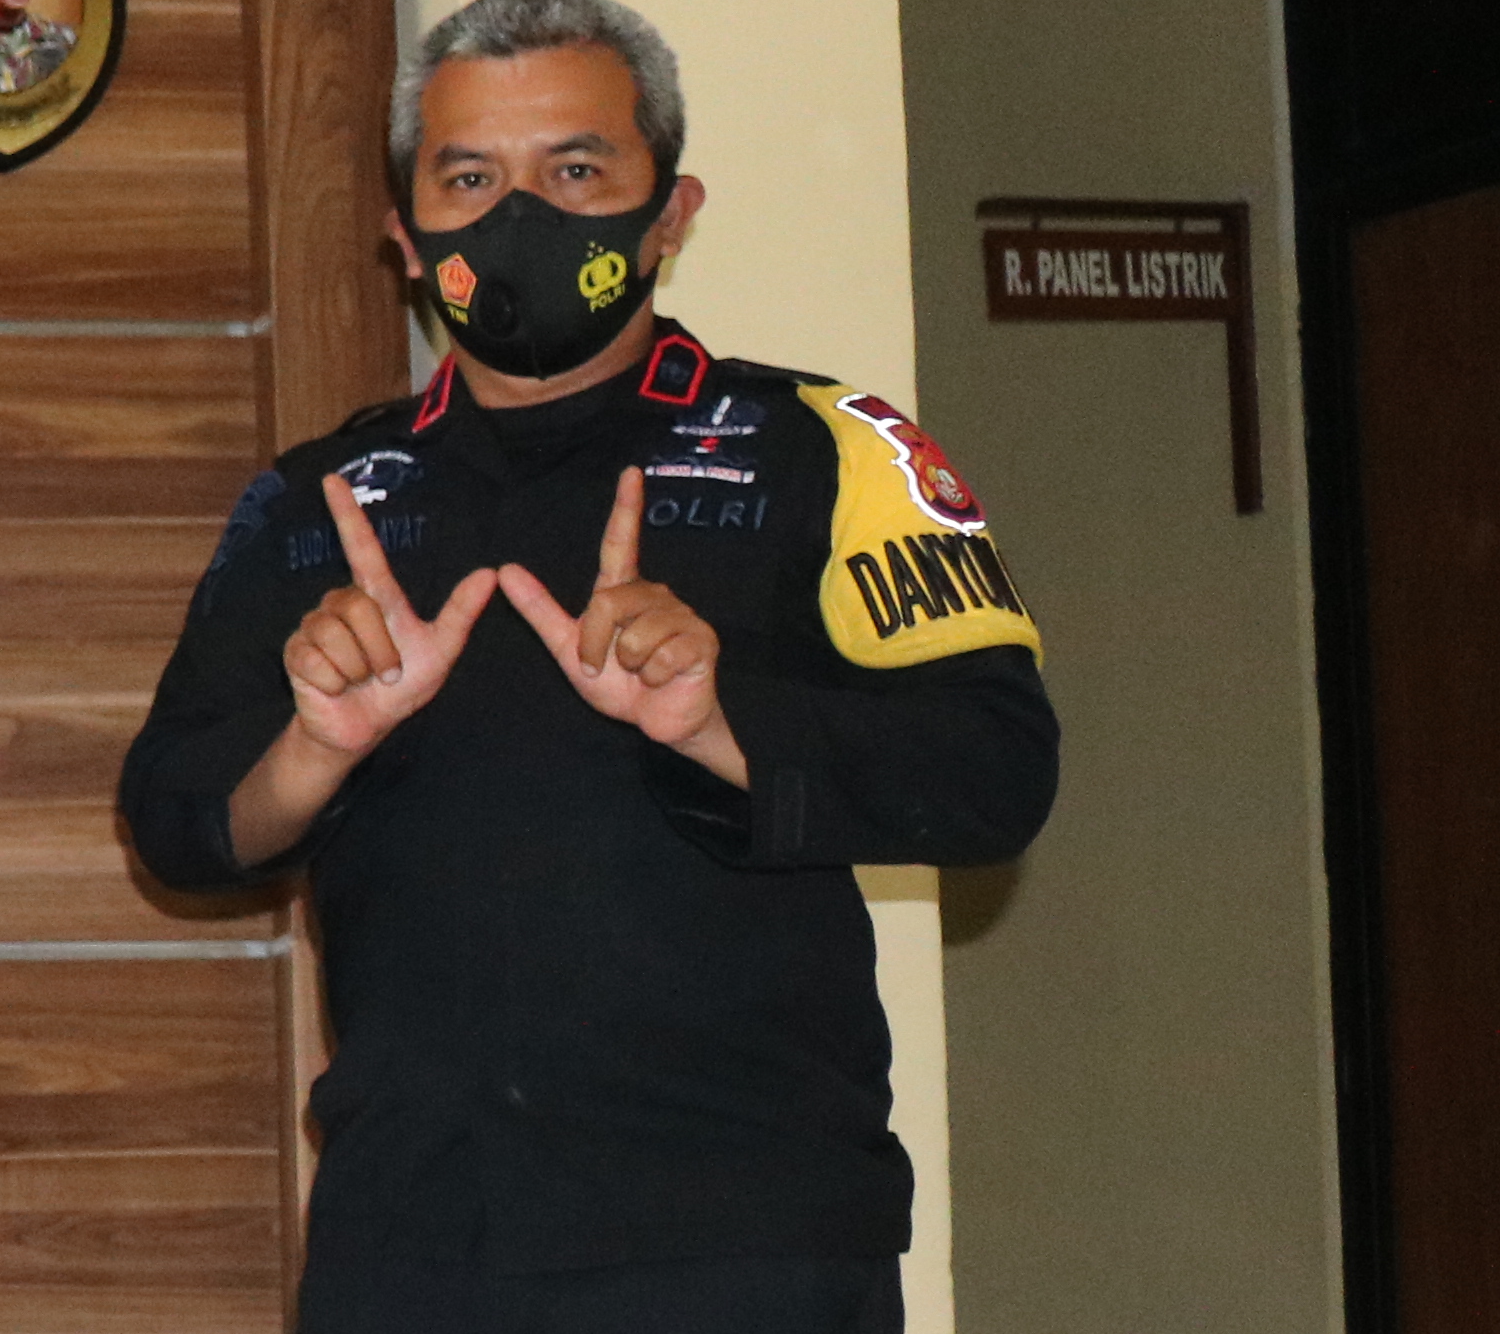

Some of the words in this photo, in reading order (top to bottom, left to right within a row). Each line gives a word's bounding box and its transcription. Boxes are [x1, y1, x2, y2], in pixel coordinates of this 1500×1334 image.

[1004, 248, 1032, 297] R.
[1037, 248, 1120, 299] PANEL
[1125, 250, 1228, 301] LISTRIK
[590, 283, 626, 313] POLRI
[647, 495, 769, 531] OLRI
